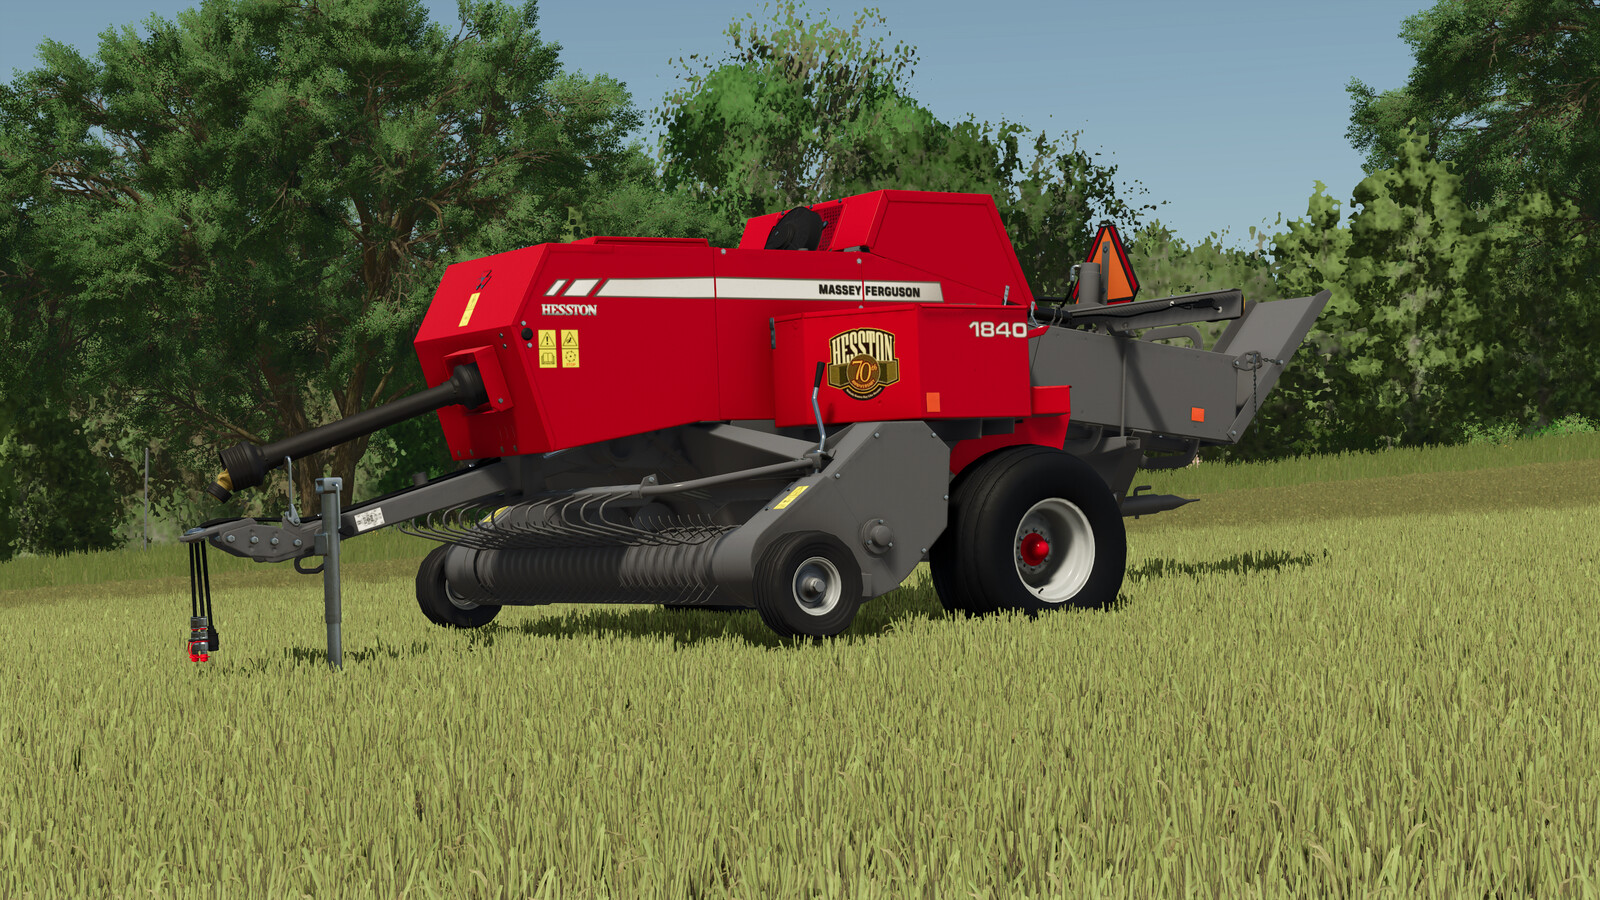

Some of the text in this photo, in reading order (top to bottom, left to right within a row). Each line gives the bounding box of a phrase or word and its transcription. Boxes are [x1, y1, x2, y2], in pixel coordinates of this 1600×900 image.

[819, 284, 921, 298] MASSEY FERGUSON
[541, 303, 597, 316] HESSTON
[969, 321, 1028, 338] 1840
[831, 330, 893, 366] HESSTON
